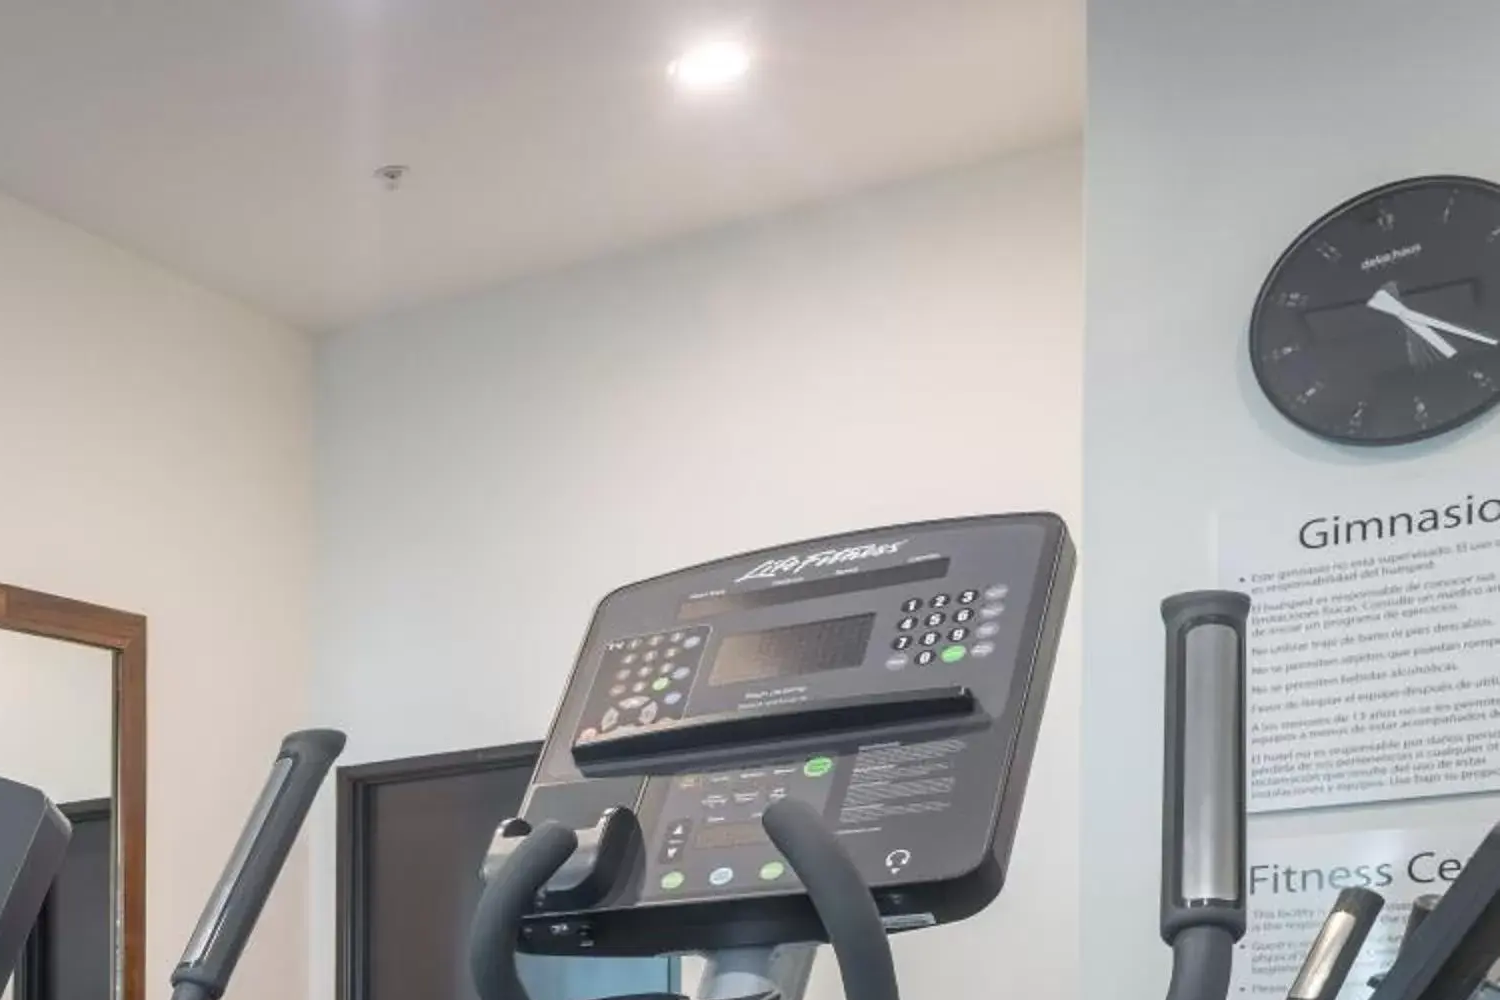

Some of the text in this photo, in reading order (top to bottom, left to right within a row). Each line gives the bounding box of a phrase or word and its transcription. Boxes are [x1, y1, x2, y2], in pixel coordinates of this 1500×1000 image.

[734, 539, 908, 583] Life Fitness
[908, 599, 916, 611] 1
[935, 595, 945, 607] 2
[962, 590, 974, 603] 3
[901, 618, 912, 630] 4
[929, 613, 941, 625] 5
[957, 609, 969, 621] 6
[898, 629, 964, 649] 7 8 9
[920, 651, 930, 664] 0
[1250, 852, 1462, 895] Fitness Ce
